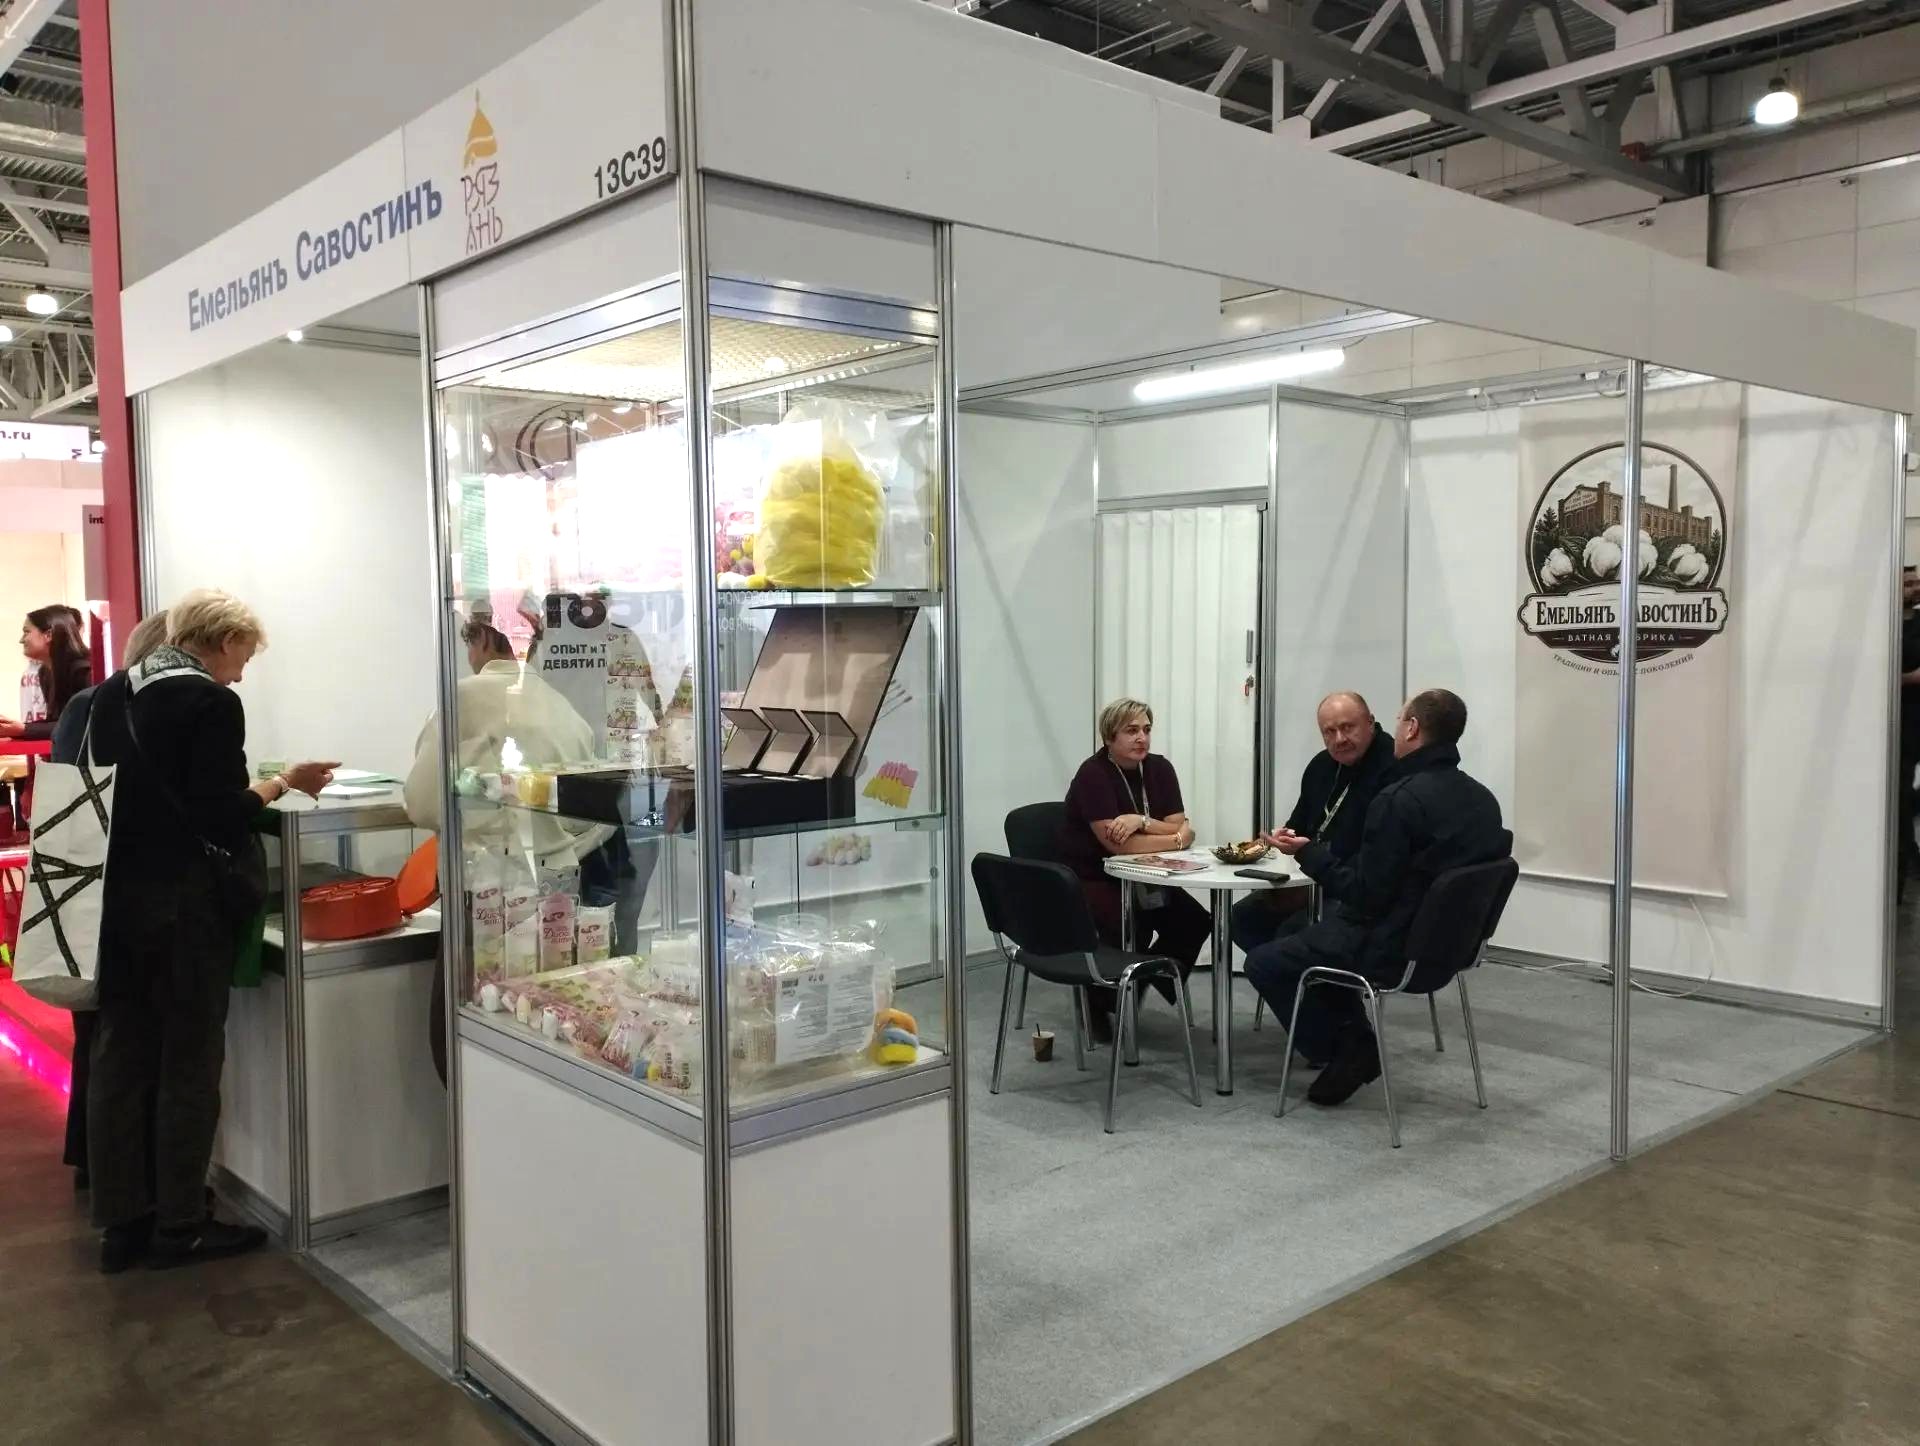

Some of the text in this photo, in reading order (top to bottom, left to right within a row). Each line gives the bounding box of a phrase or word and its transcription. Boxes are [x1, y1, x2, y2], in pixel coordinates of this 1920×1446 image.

[594, 136, 666, 199] 13C39
[1567, 634, 1612, 642] ВАТНАЯ
[550, 644, 588, 655] ОПЫТ
[543, 658, 595, 671] ДЕВЯТИ
